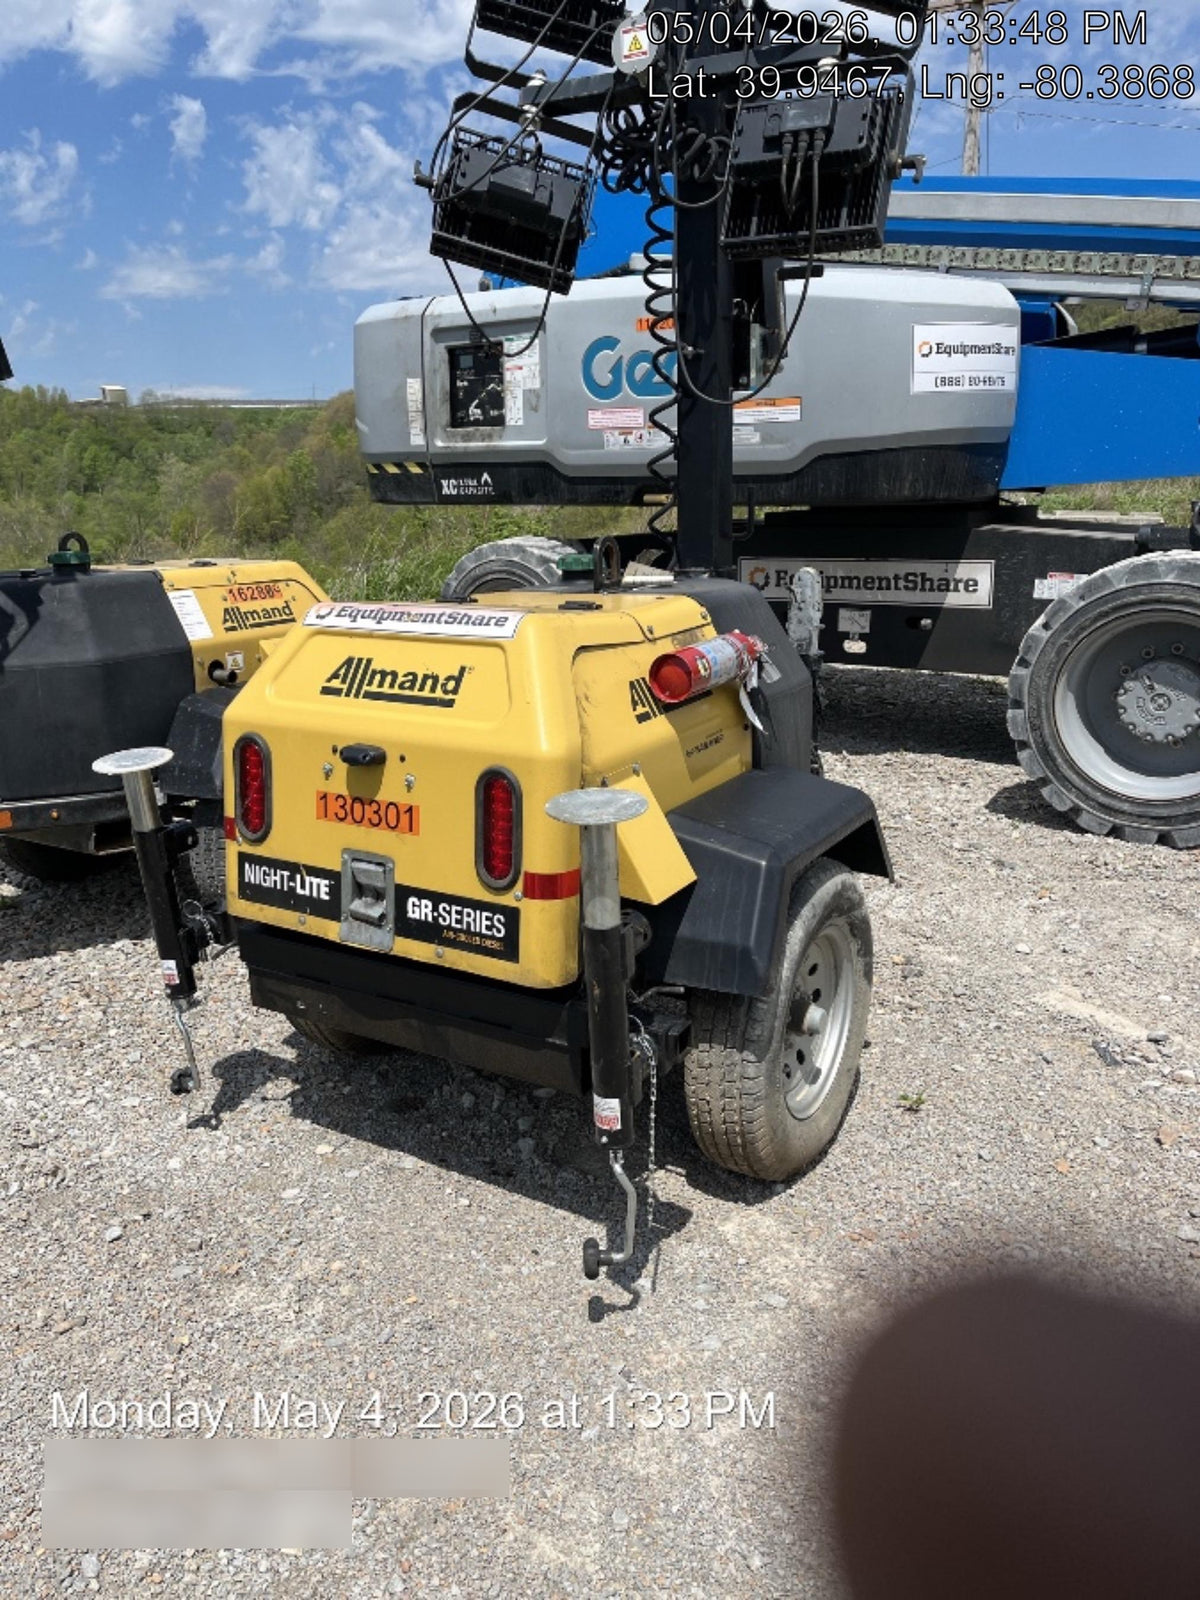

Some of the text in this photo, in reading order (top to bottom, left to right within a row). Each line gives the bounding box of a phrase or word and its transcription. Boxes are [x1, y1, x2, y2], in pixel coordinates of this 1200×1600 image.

[774, 568, 979, 595] EipmentShare
[223, 600, 296, 631] Allmand
[320, 655, 467, 708] Allmand
[319, 794, 415, 832] 130301
[244, 862, 331, 900] NIGHT-LITE
[407, 896, 506, 938] GR-SERIES
